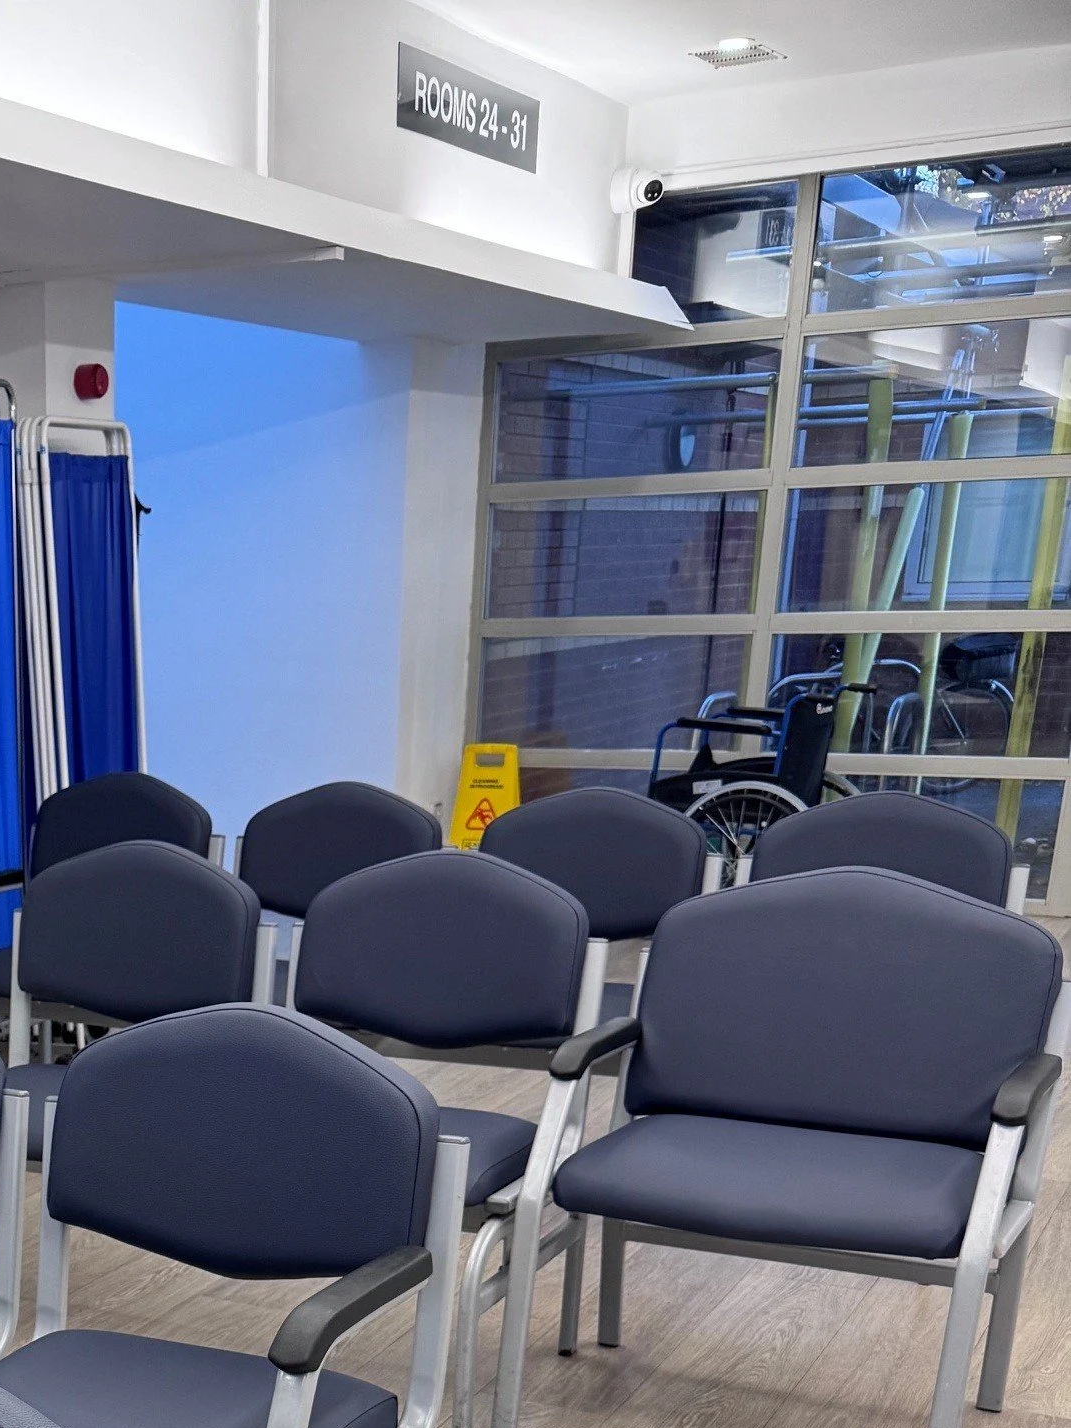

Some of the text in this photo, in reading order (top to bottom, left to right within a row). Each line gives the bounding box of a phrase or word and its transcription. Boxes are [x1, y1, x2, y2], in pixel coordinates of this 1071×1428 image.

[414, 70, 527, 151] ROOMS 24 - 31
